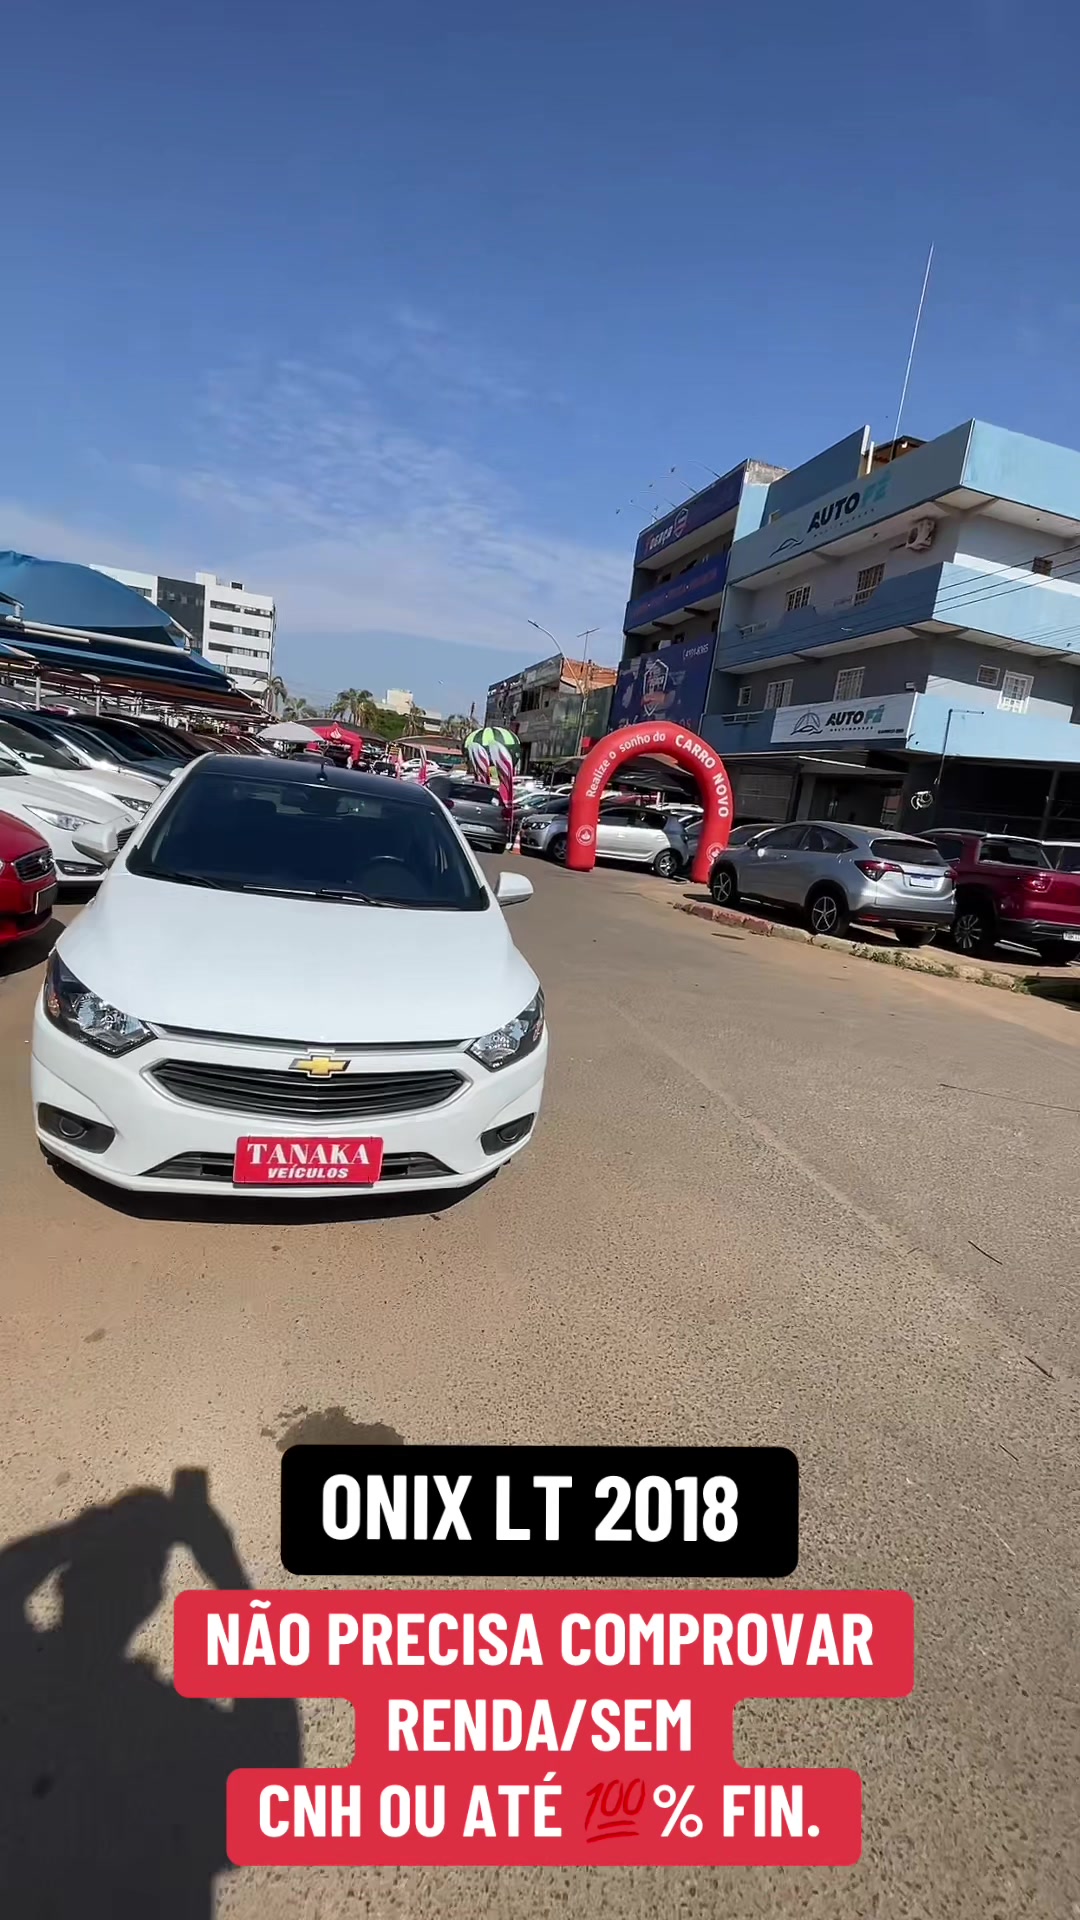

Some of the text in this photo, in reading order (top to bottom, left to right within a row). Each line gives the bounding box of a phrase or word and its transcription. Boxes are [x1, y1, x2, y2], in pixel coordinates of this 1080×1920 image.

[586, 760, 610, 798] Realize
[619, 734, 651, 752] sonho
[652, 731, 666, 742] do
[675, 735, 716, 769] CARRO
[713, 773, 729, 818] NOVO
[247, 1143, 369, 1165] TANAKA
[268, 1164, 349, 1178] VEÍCULOS
